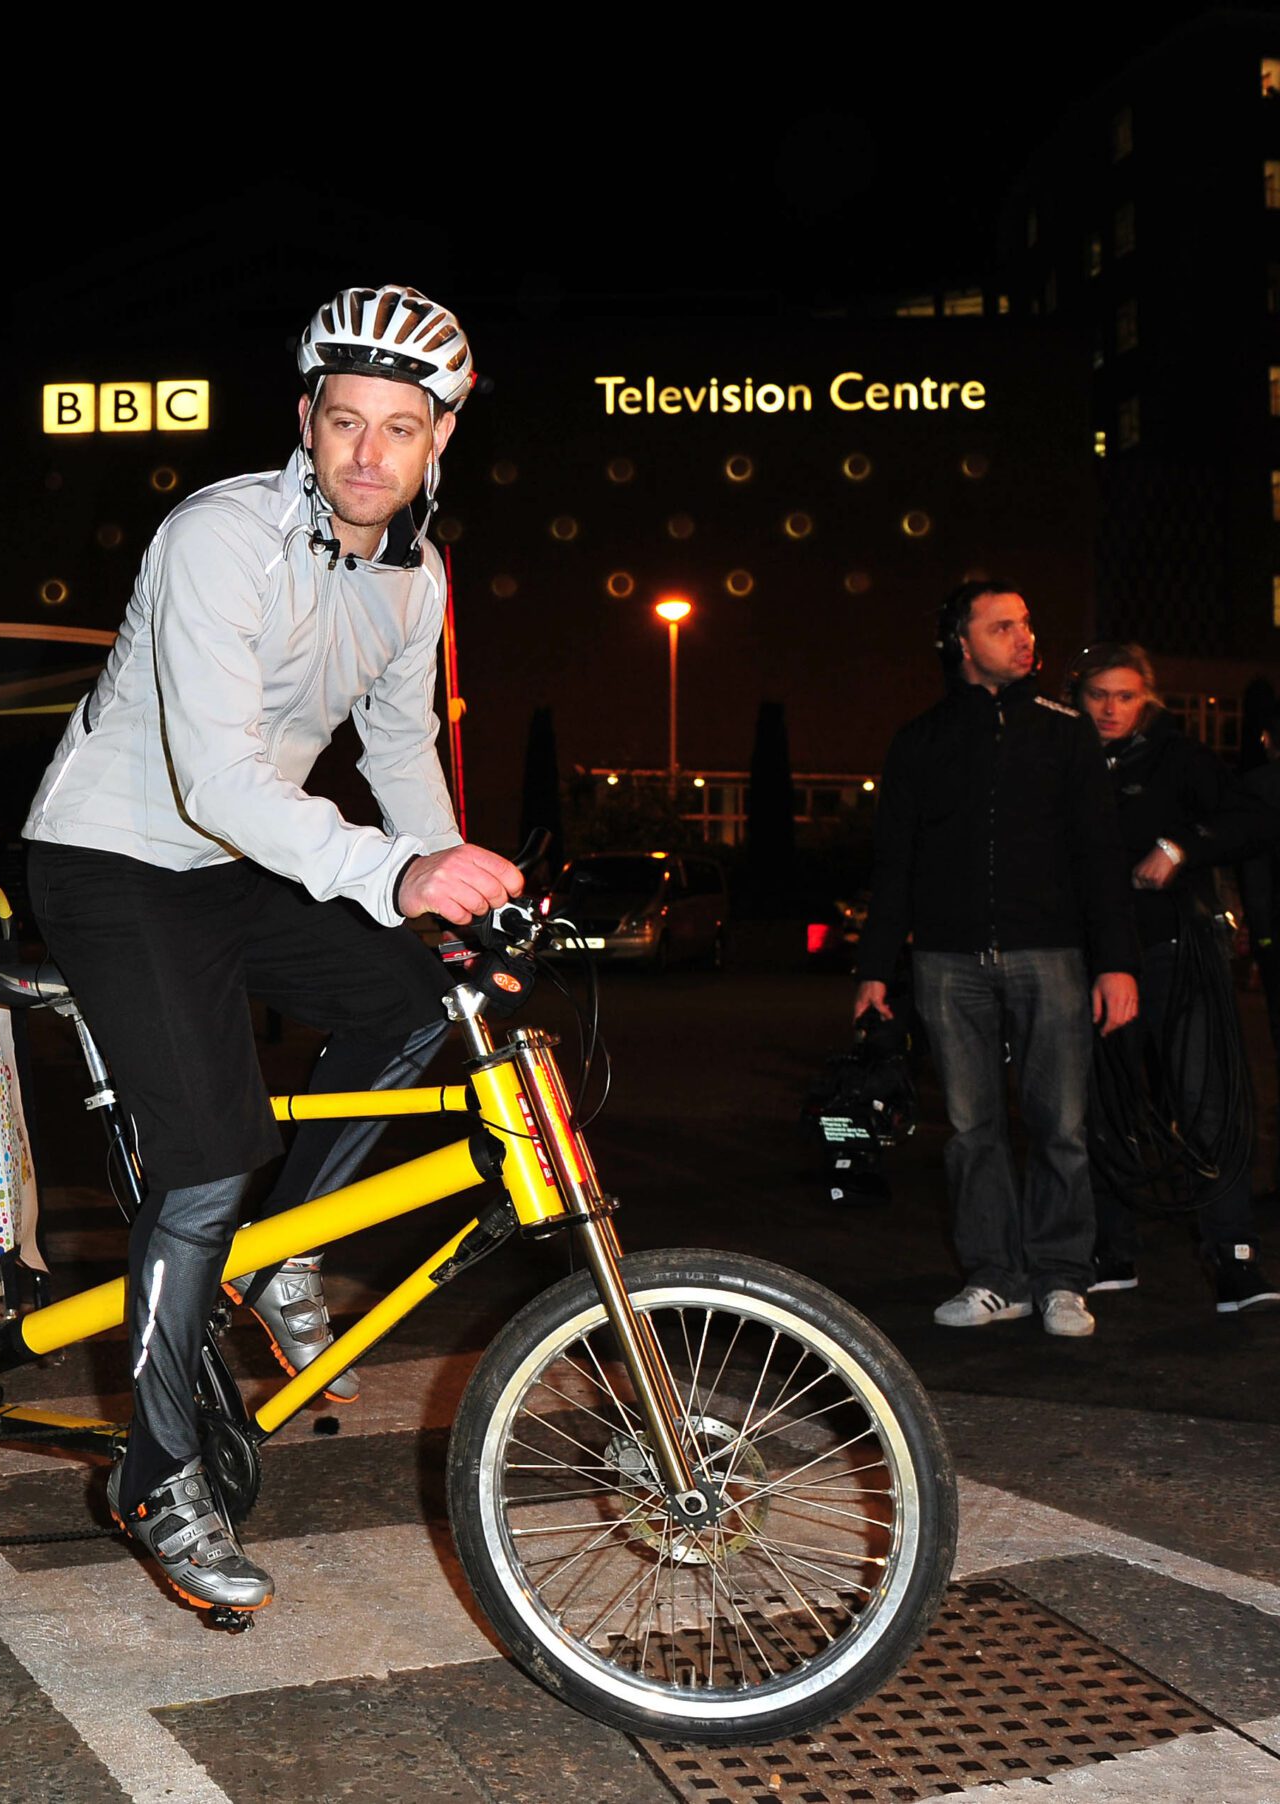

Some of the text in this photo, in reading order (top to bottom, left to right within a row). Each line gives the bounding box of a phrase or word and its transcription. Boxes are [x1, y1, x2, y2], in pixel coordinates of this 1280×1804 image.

[54, 385, 202, 428] BBC
[594, 371, 987, 415] Television Centre
